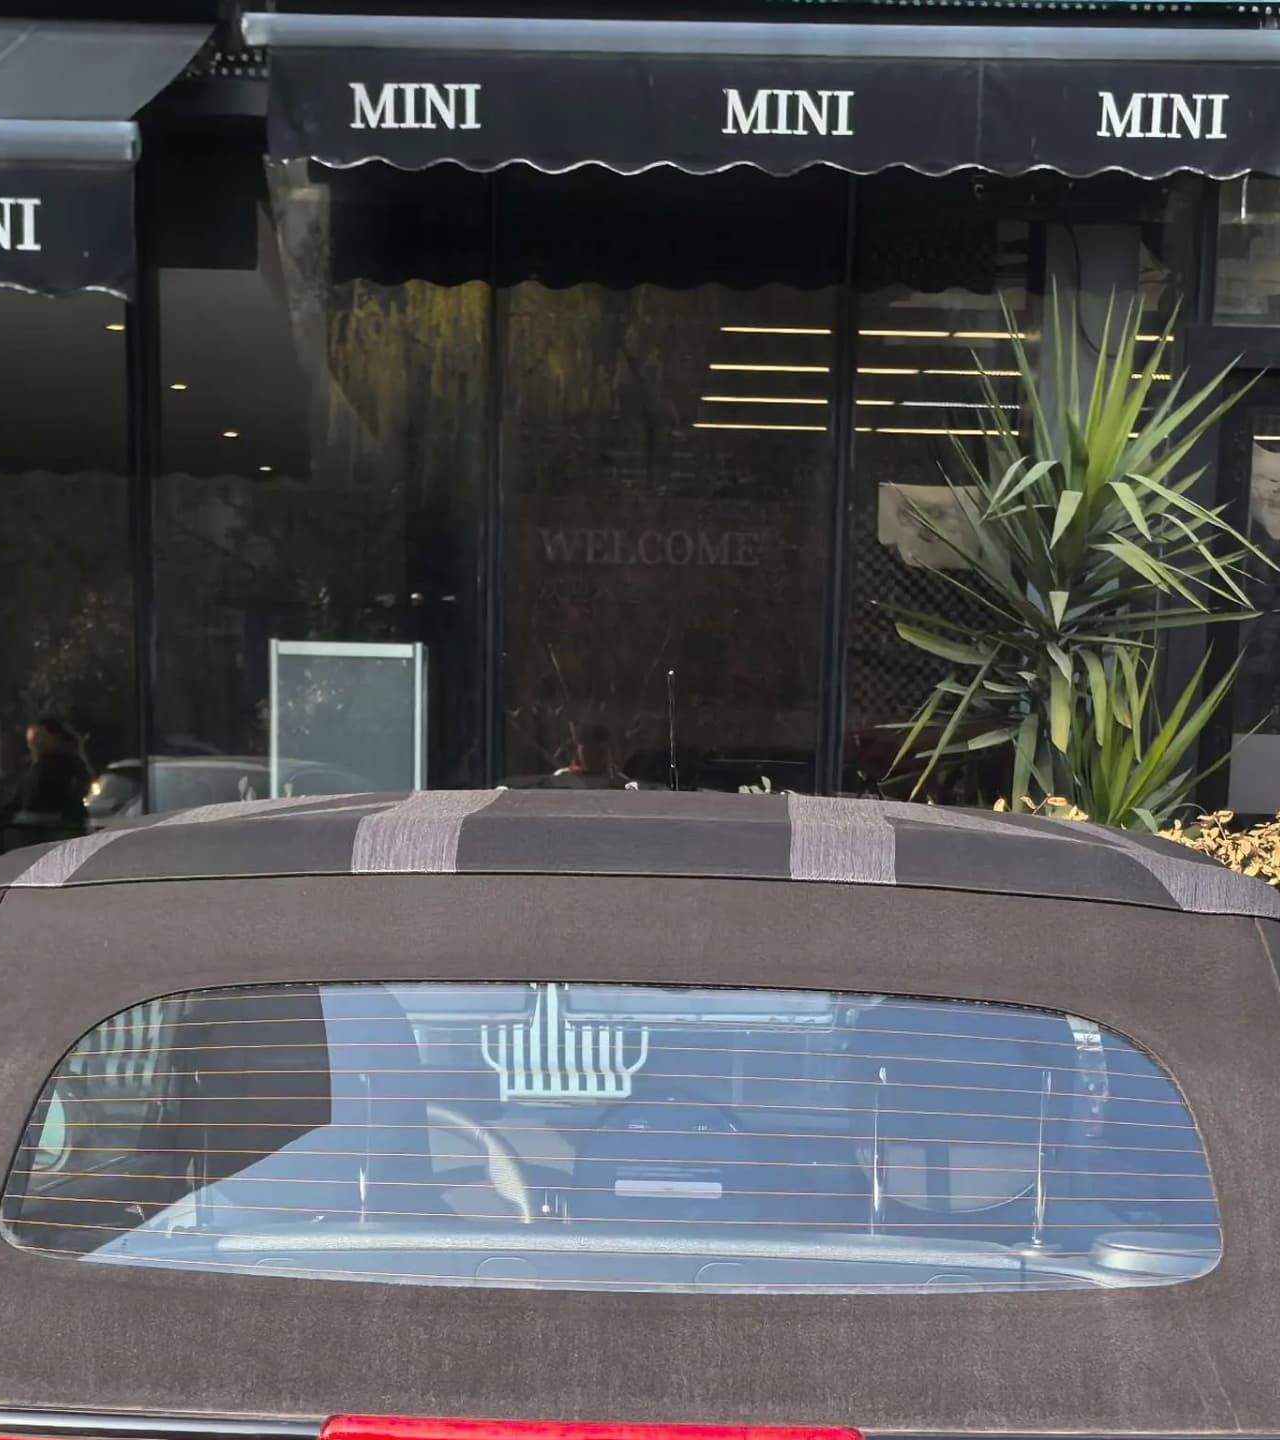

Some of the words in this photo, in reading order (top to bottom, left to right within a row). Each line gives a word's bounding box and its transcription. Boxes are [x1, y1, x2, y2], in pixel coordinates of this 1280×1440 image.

[348, 82, 482, 130] MINI
[721, 88, 855, 136] MINI
[1096, 91, 1230, 140] MINI
[539, 528, 761, 567] WELCOME
